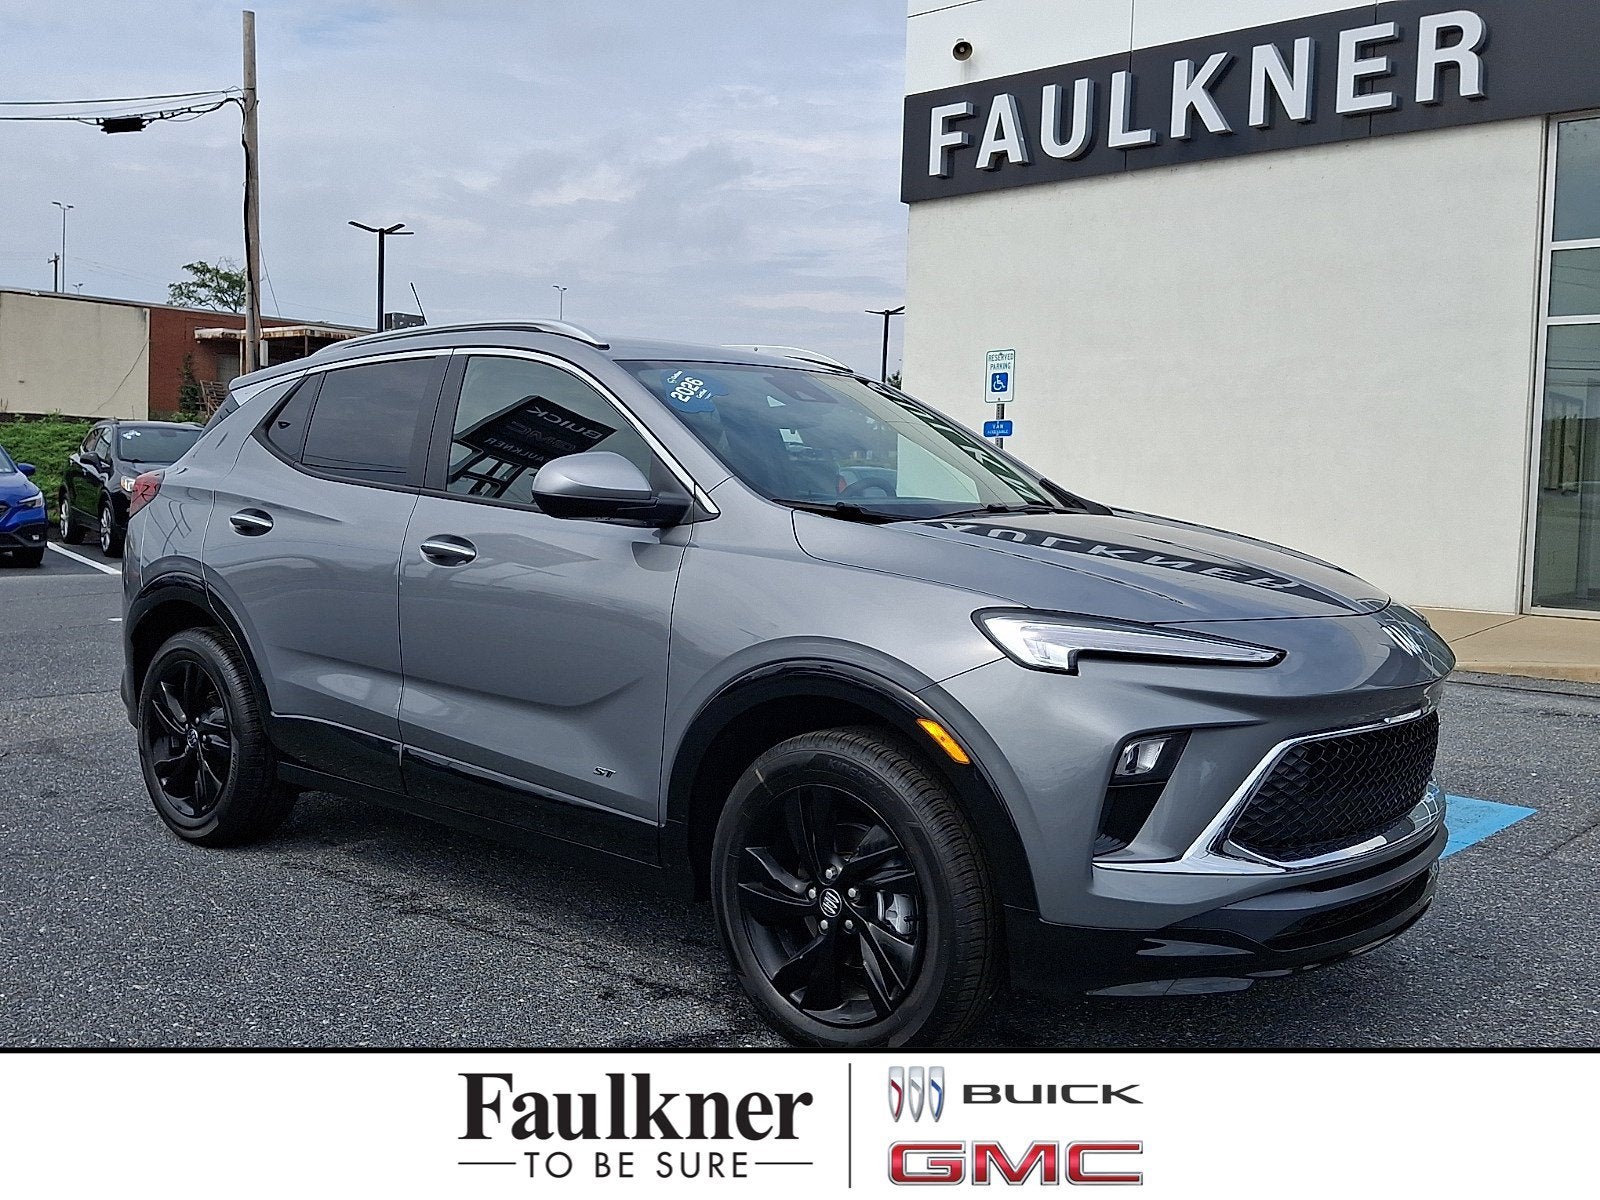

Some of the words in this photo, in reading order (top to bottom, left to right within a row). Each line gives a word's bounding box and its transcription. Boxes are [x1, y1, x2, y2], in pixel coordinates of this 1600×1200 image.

[928, 10, 1487, 178] FAULKNER
[988, 352, 1013, 361] RESERVED
[990, 362, 1011, 370] PARKING
[670, 376, 704, 403] 2026
[592, 766, 617, 778] ST
